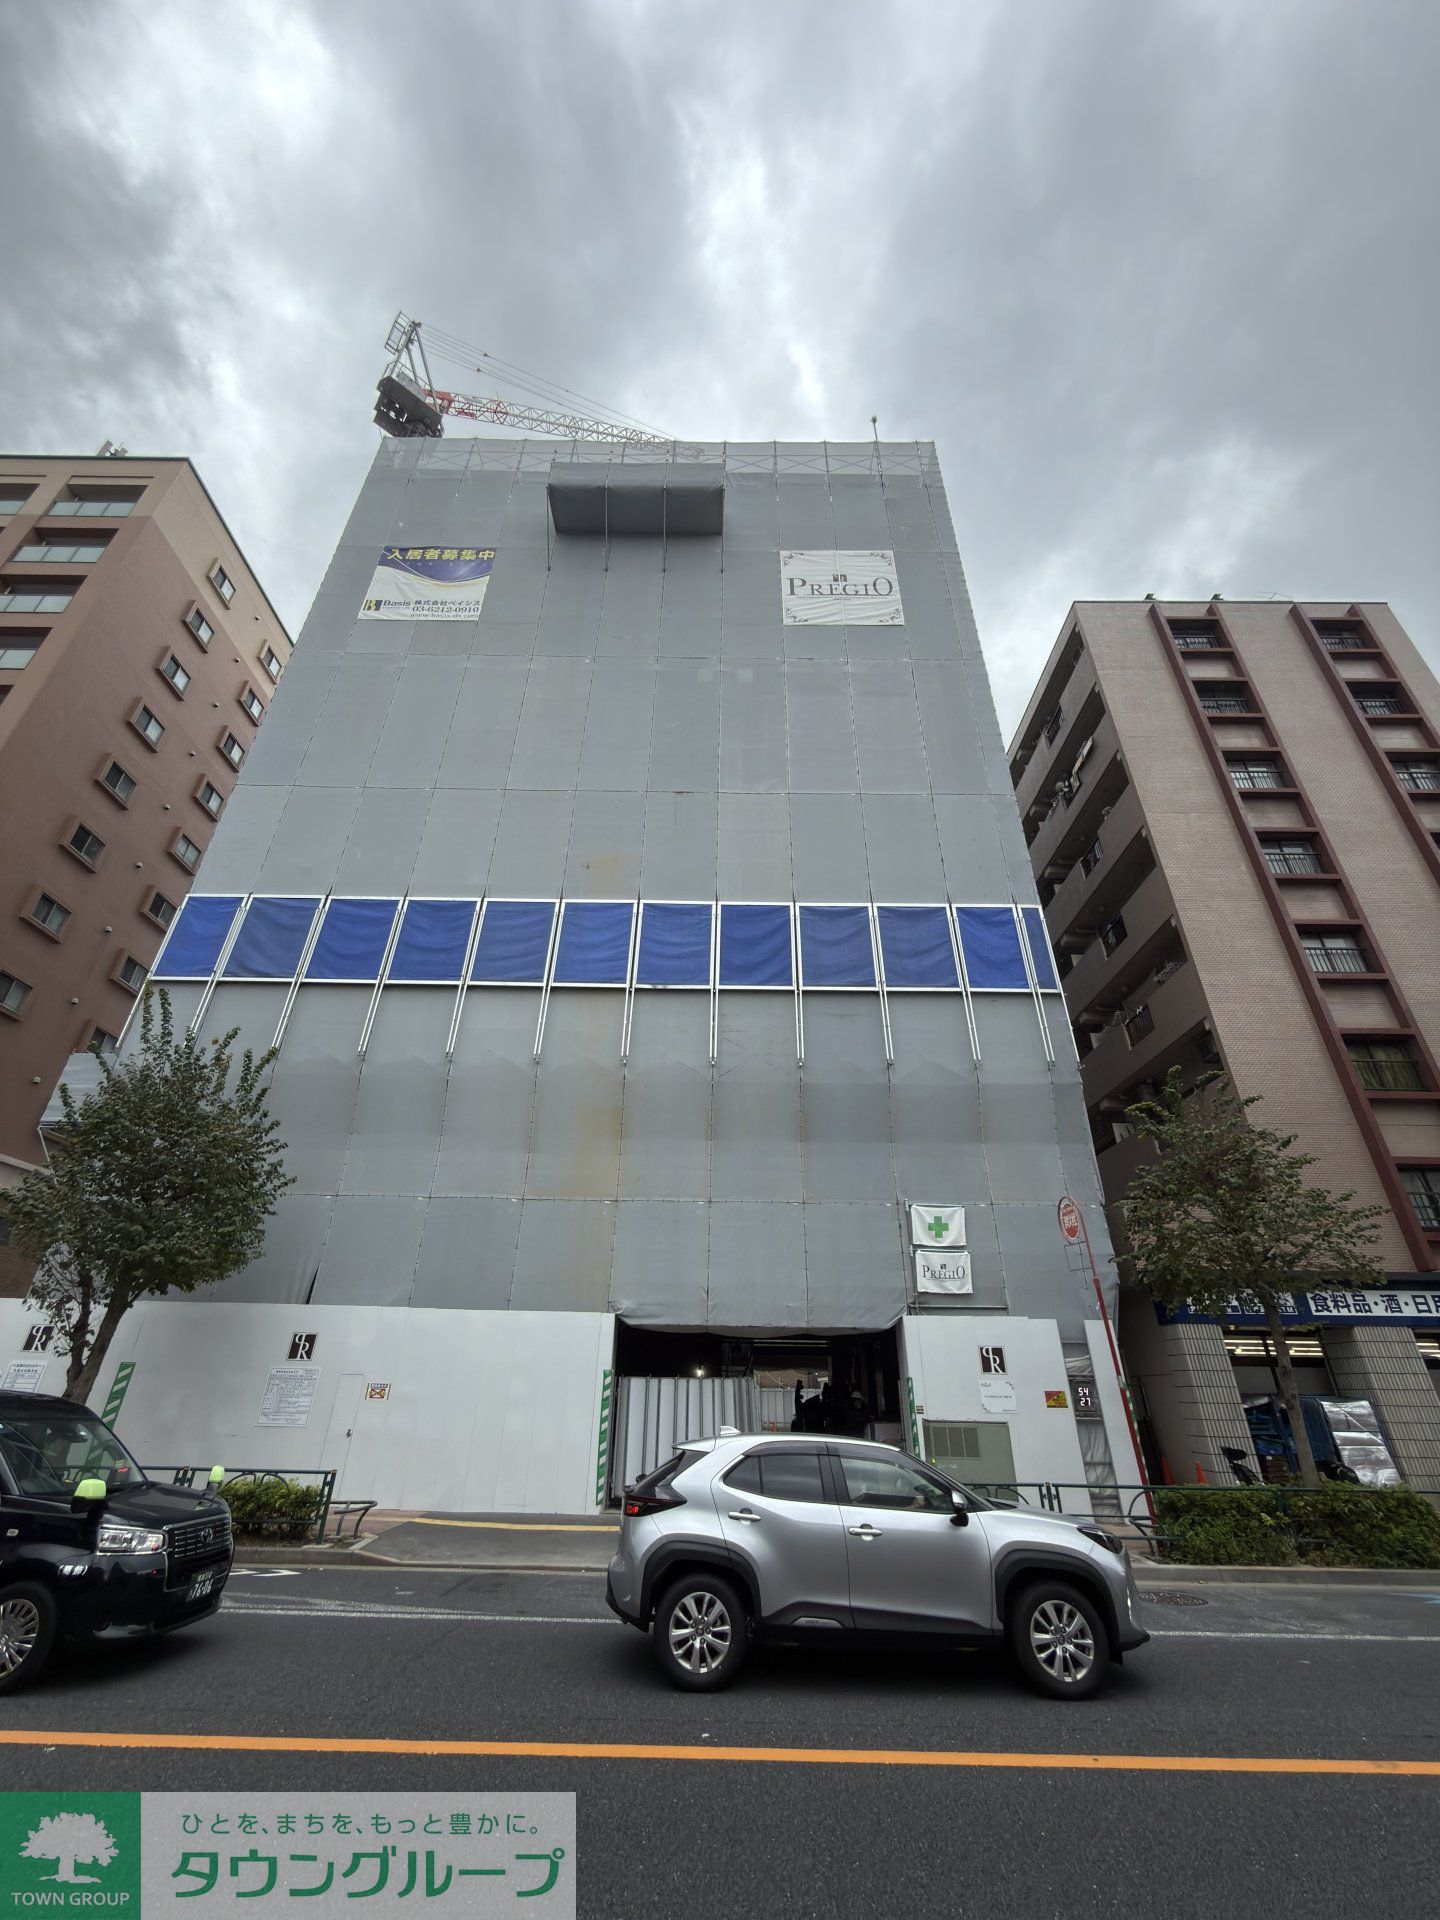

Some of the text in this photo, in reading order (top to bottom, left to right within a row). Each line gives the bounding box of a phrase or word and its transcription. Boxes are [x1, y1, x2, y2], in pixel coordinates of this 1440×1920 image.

[387, 548, 495, 561] 入居者募集中
[1078, 1387, 1089, 1396] 54
[1080, 1397, 1091, 1406] 27
